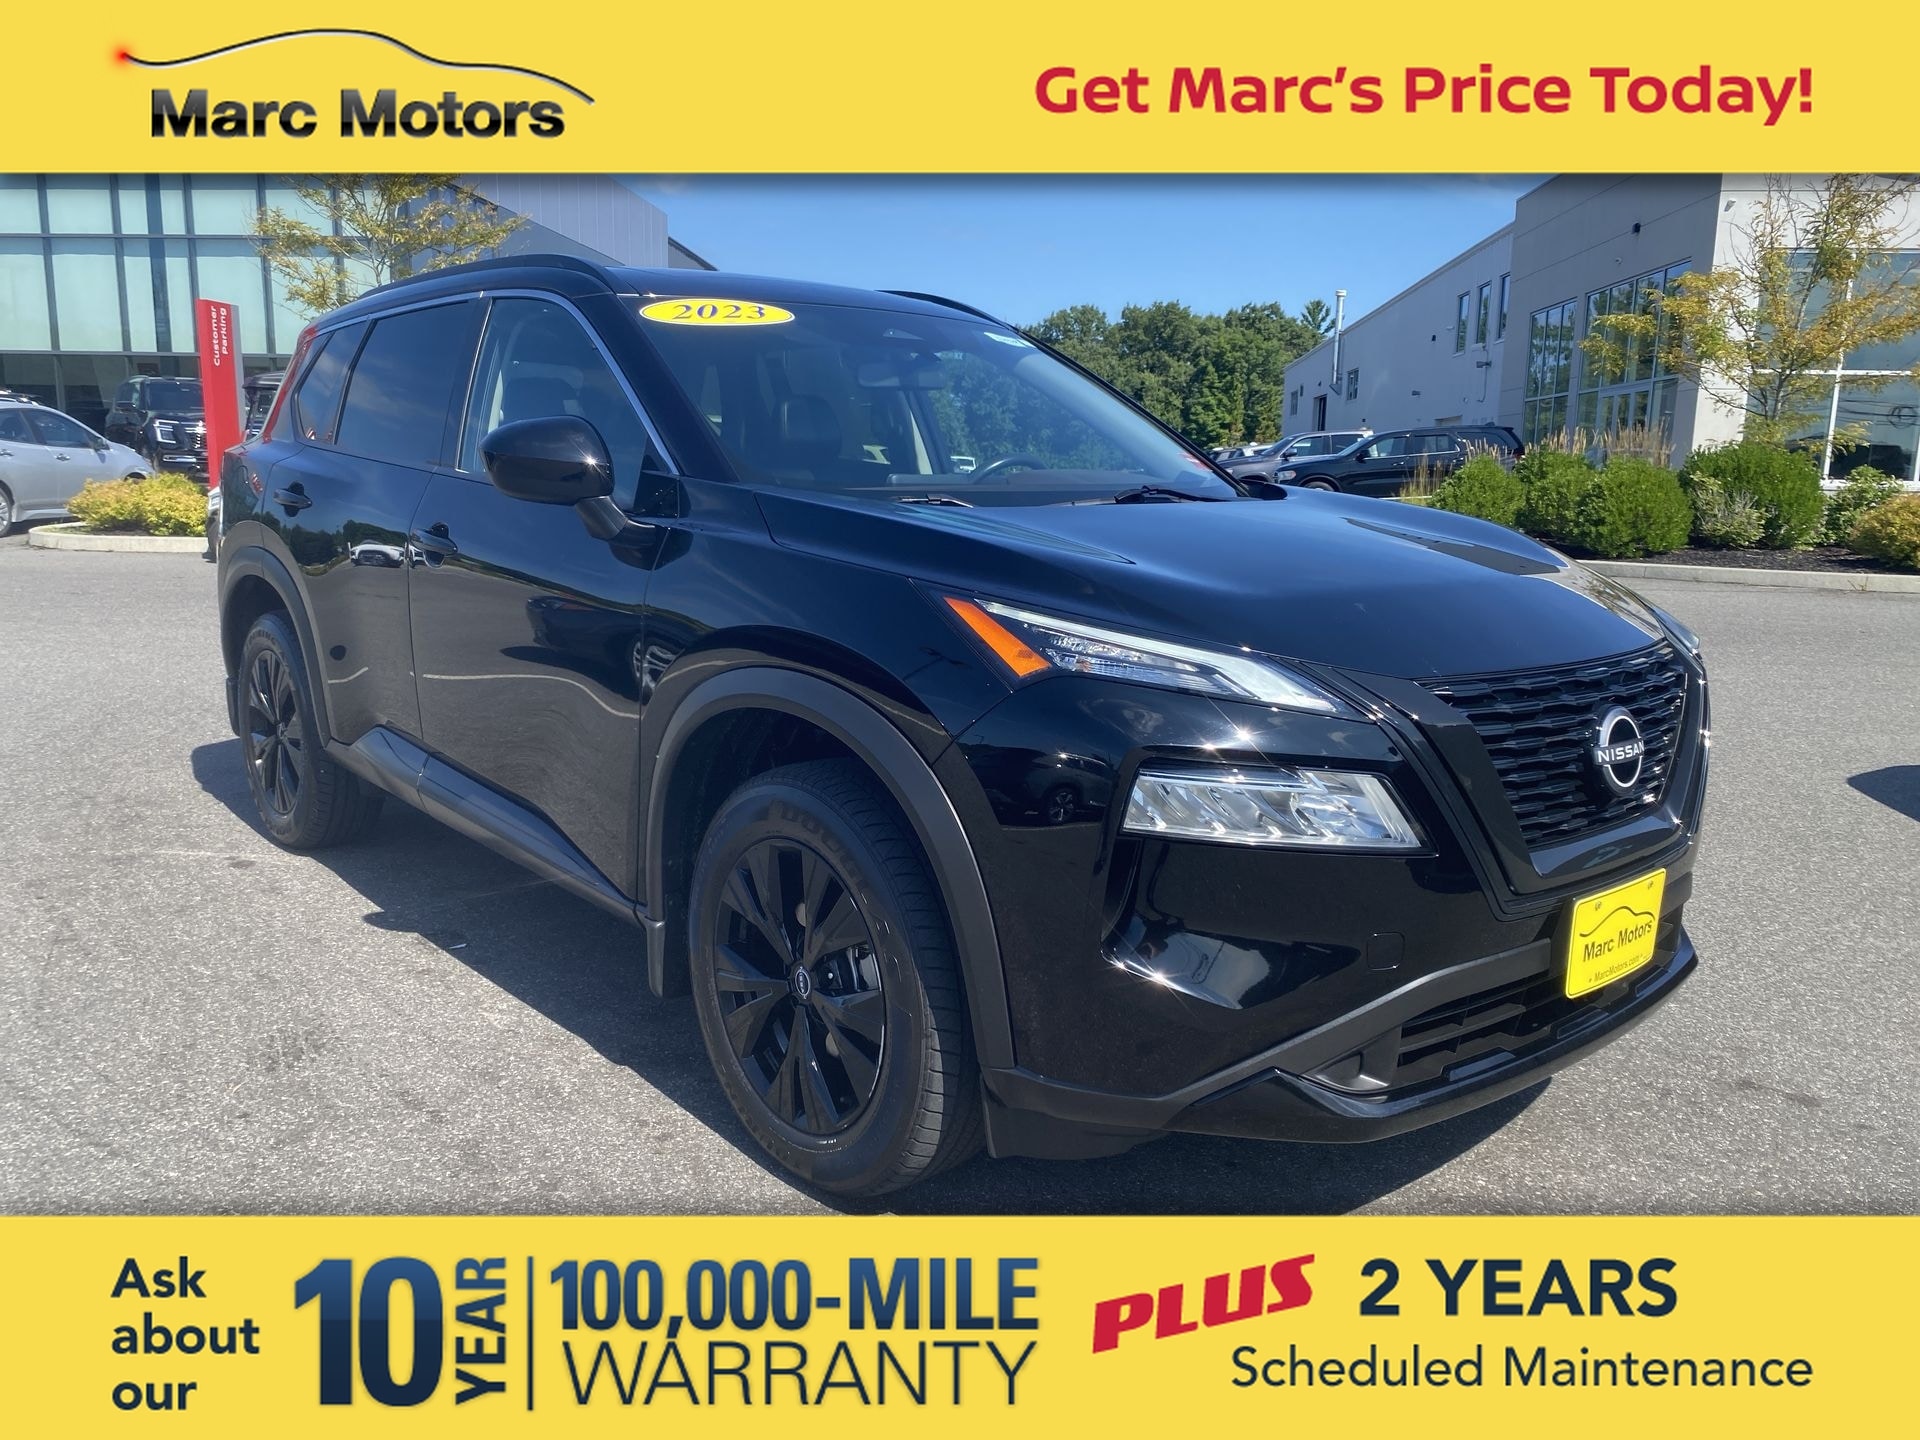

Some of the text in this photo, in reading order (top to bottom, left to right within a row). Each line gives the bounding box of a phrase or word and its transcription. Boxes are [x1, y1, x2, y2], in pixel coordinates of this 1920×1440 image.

[219, 307, 229, 355] Parking
[671, 303, 766, 320] 2023
[210, 305, 221, 367] Customer
[1597, 739, 1646, 763] NISSAN
[1582, 920, 1653, 962] Marc Motors
